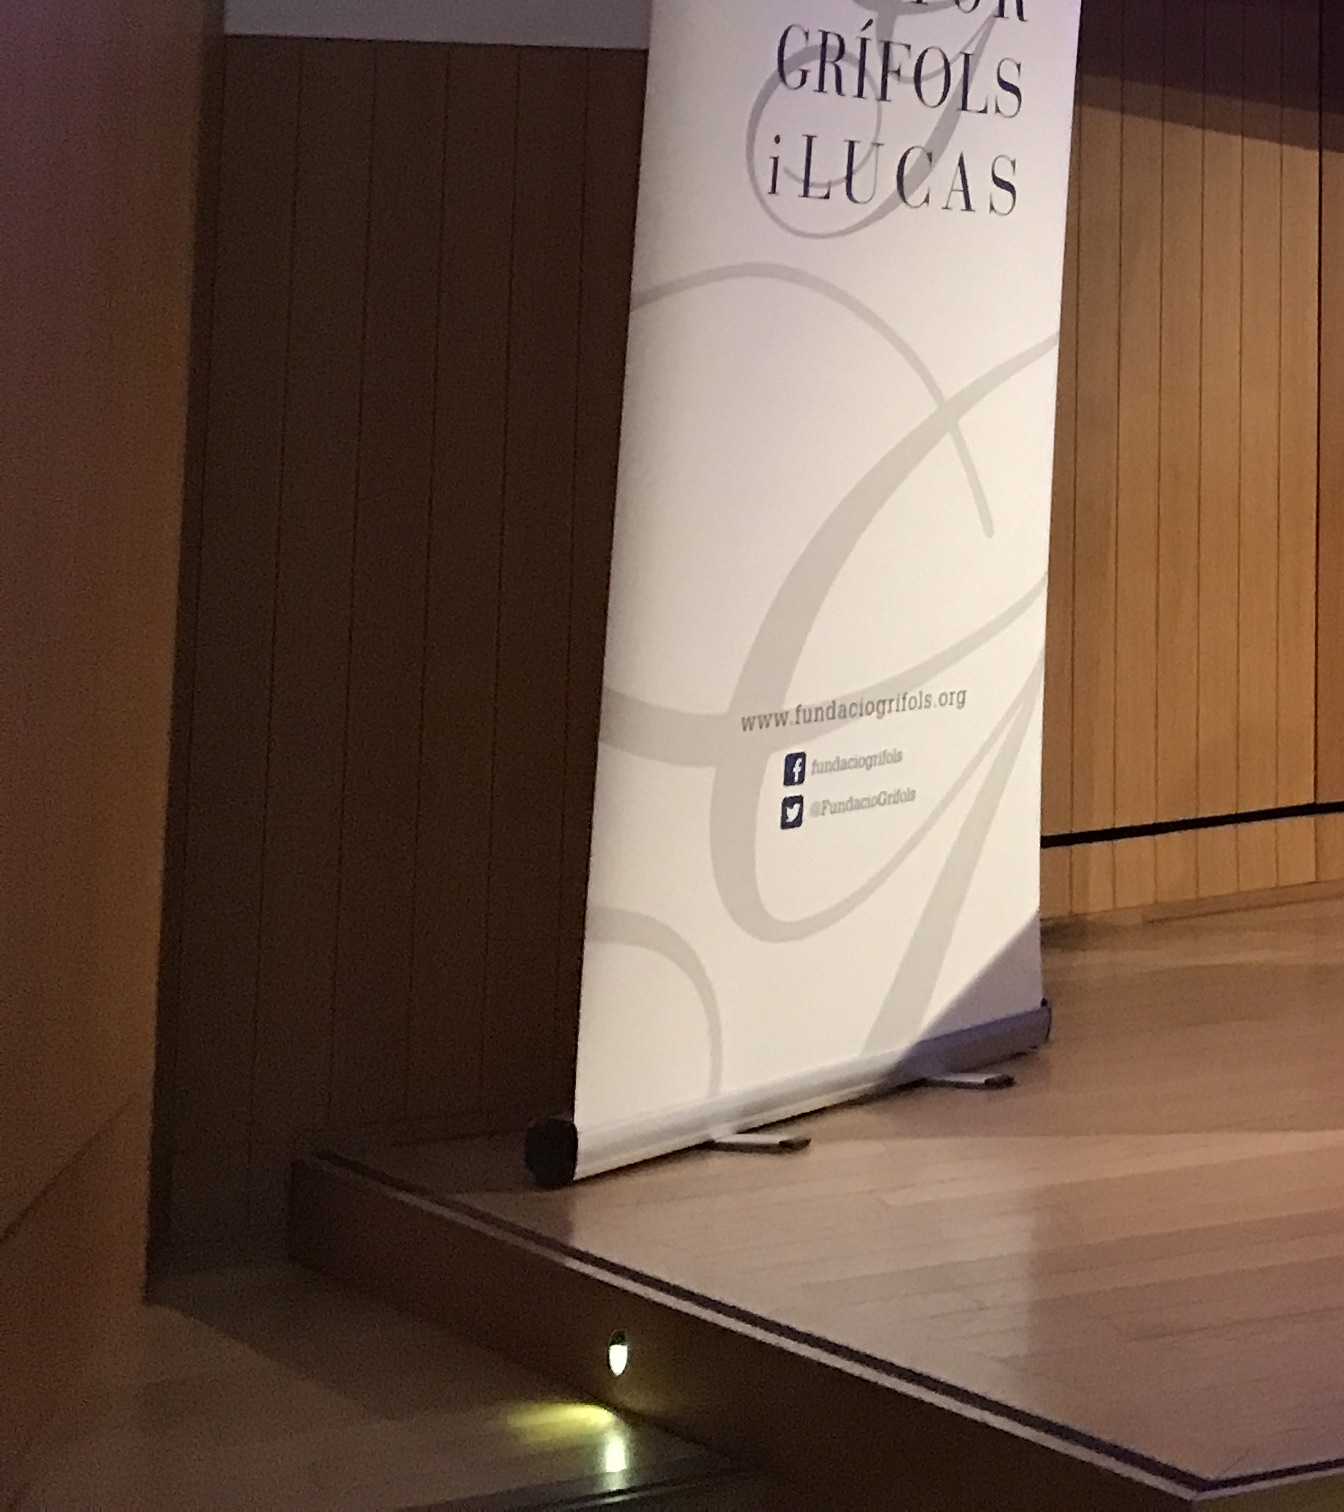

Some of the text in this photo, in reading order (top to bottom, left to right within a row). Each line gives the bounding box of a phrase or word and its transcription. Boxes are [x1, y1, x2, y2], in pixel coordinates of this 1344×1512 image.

[777, 19, 1023, 118] GRÍFOLS
[768, 134, 1017, 216] i LUCAS
[741, 689, 967, 732] www.fundaciogrifols.org
